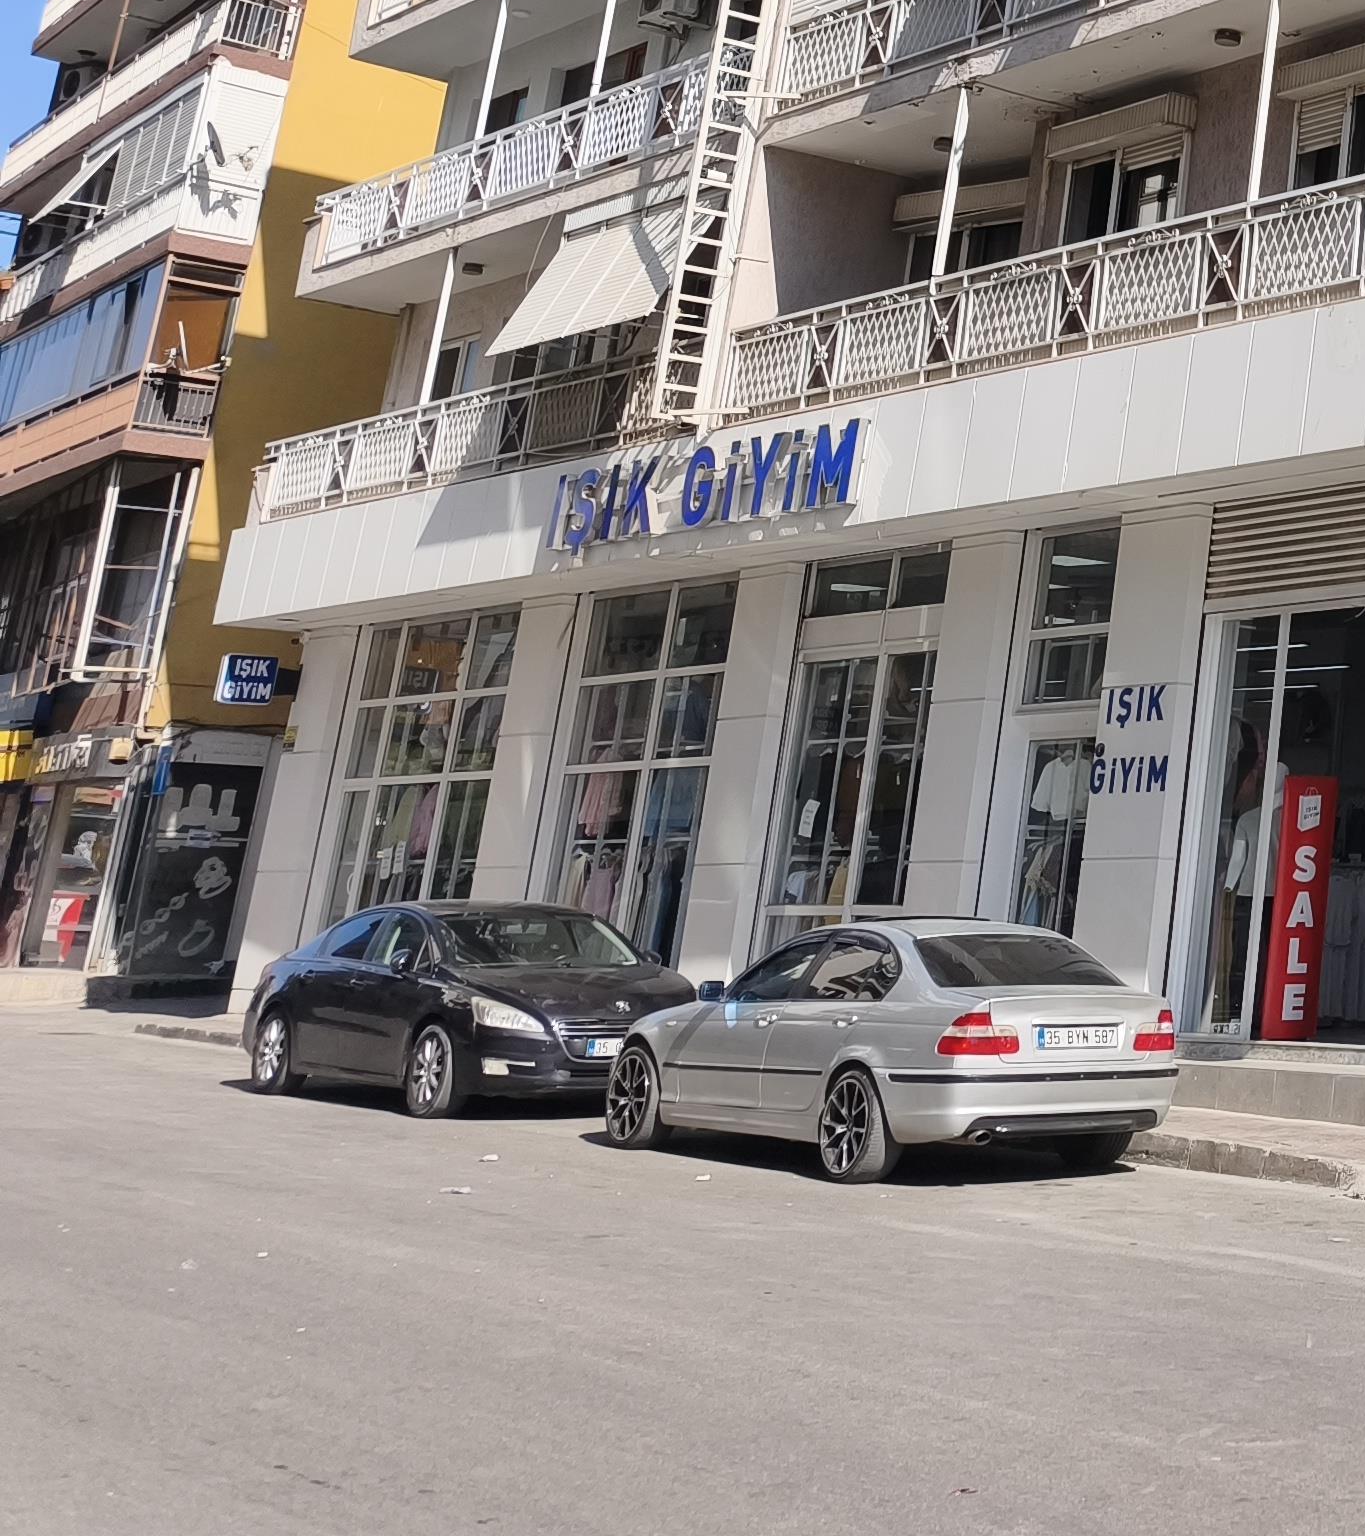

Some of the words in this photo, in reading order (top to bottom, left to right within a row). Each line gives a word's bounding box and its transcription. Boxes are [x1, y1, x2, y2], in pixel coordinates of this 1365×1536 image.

[545, 455, 661, 558] IŞIK
[233, 658, 269, 679] IŞIK
[1105, 684, 1168, 729] IŞIK
[1281, 845, 1318, 1021] SALE
[596, 1041, 609, 1054] 35
[1046, 1030, 1060, 1045] 35
[1067, 1029, 1089, 1045] BYN
[1094, 1029, 1115, 1044] 587
